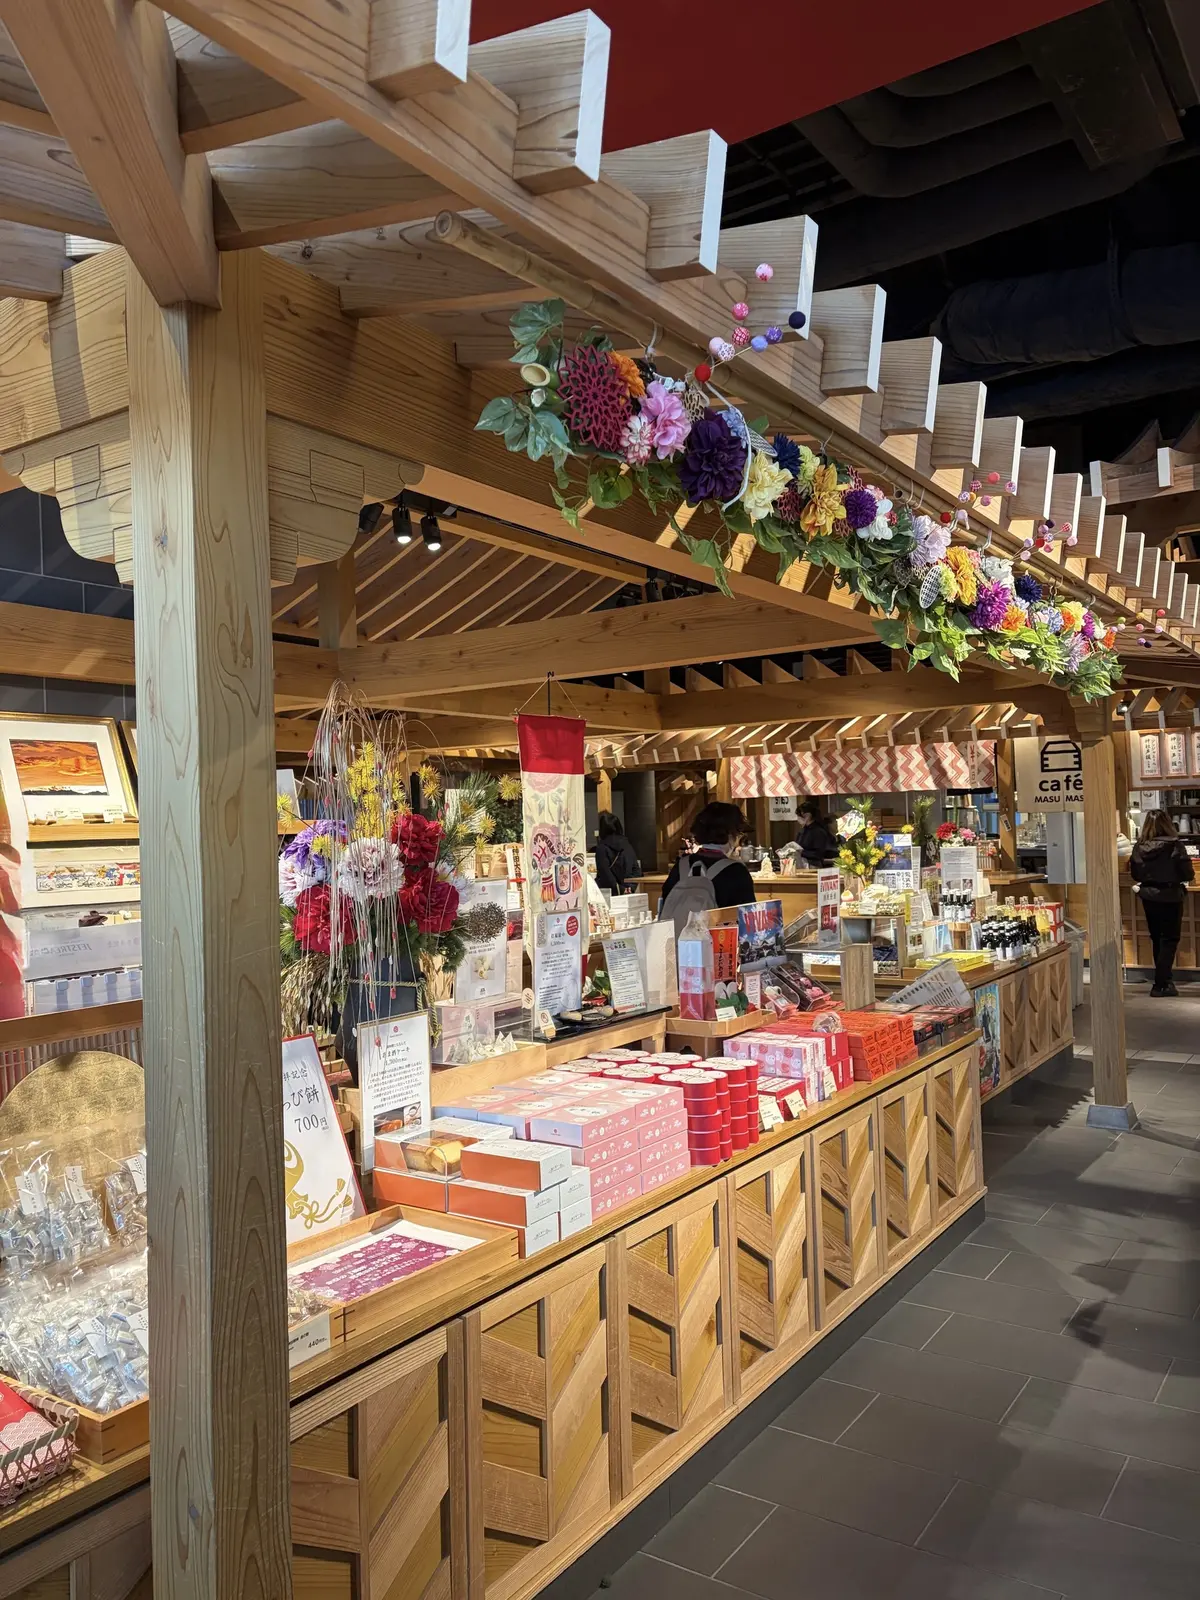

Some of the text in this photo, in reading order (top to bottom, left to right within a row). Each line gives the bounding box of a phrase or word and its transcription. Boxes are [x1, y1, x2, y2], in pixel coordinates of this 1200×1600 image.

[1039, 773, 1083, 791] café
[1035, 794, 1084, 803] MASU MAS
[294, 1114, 327, 1133] 700円
